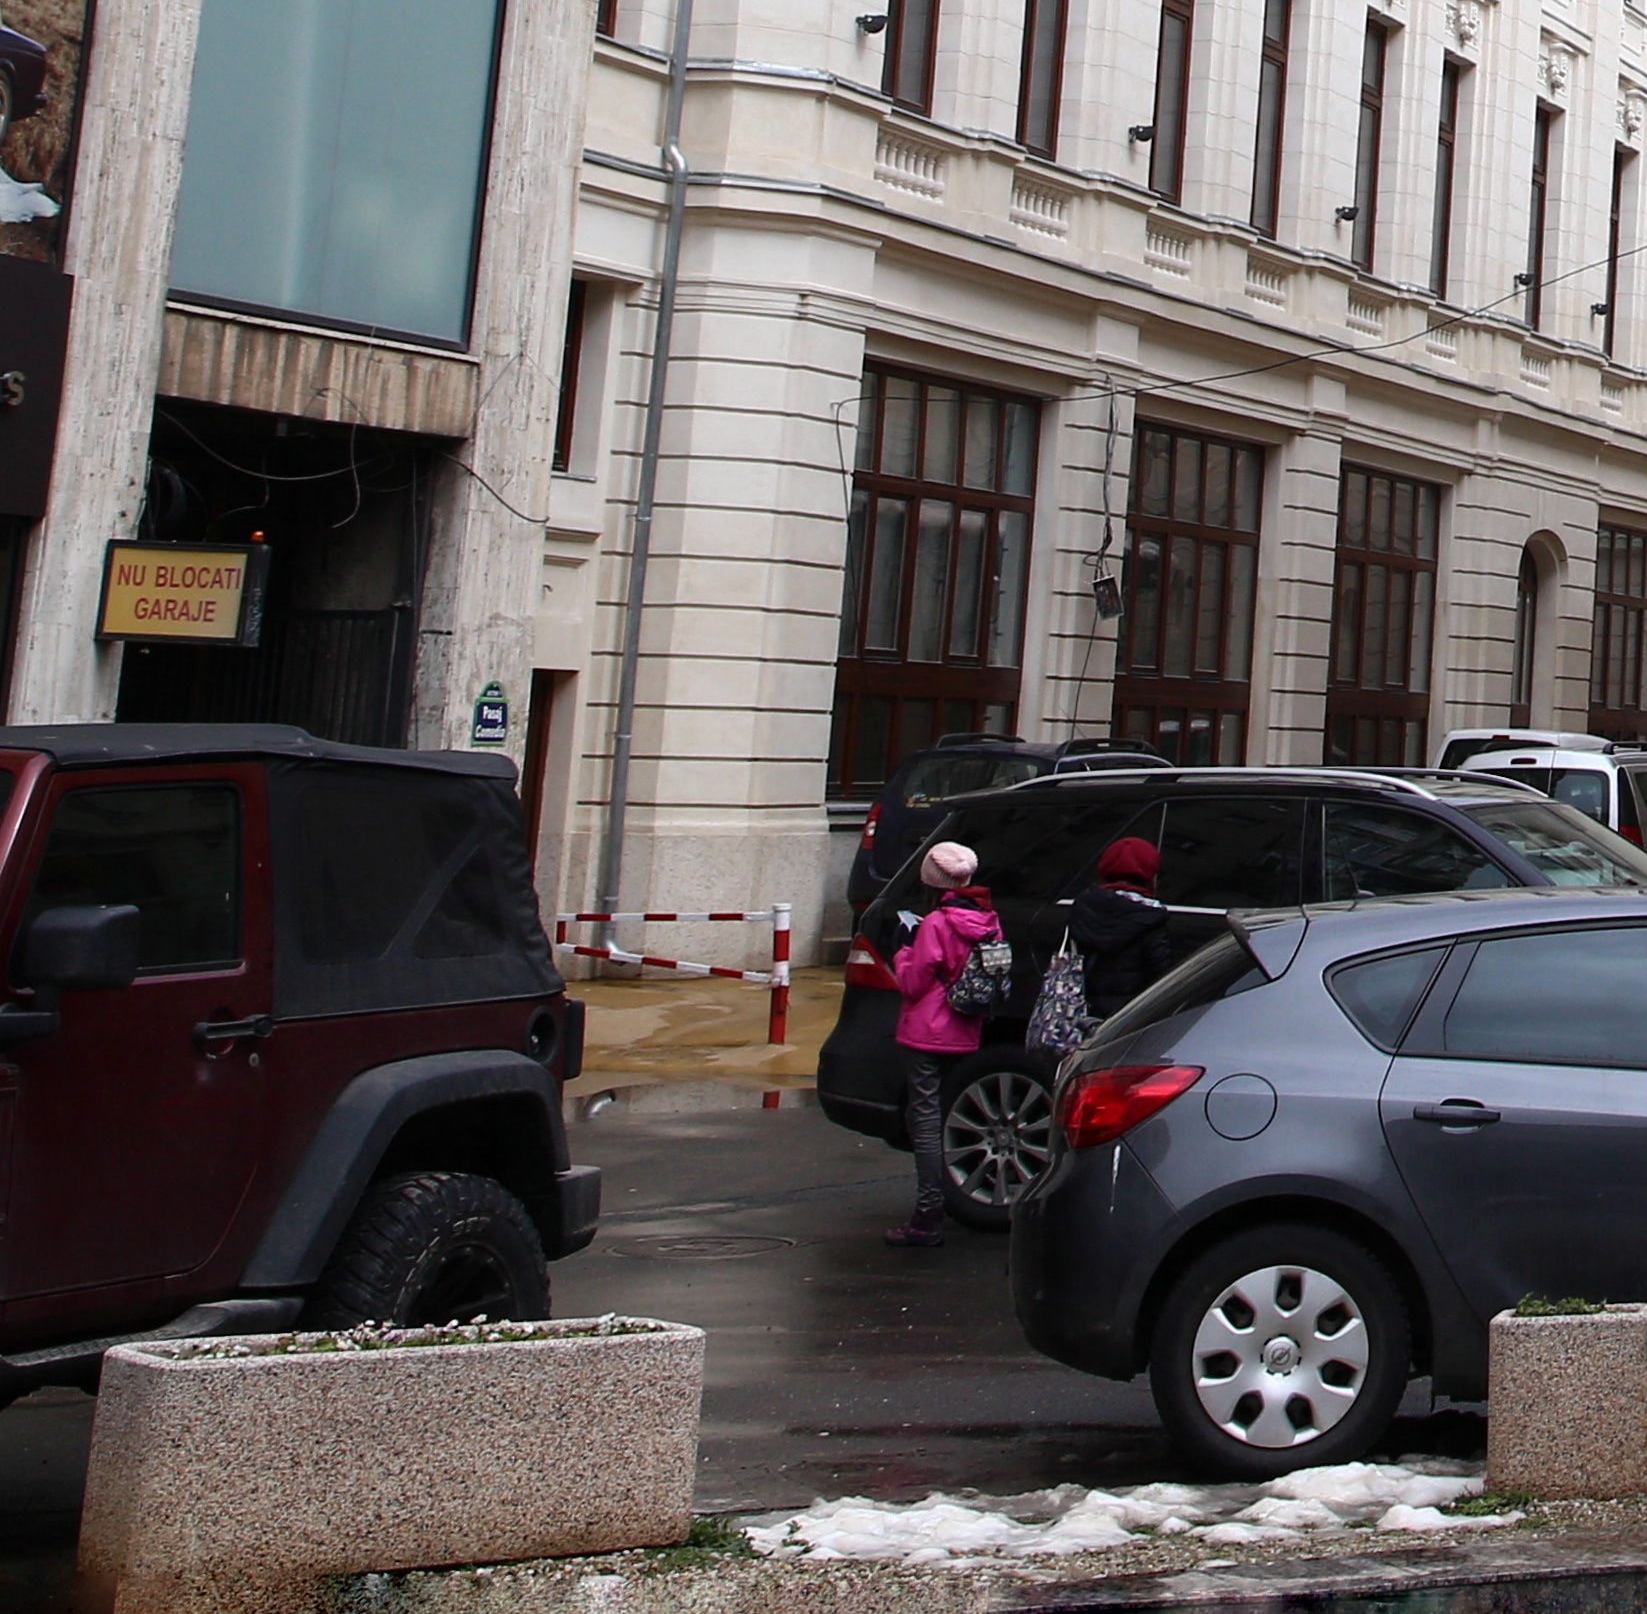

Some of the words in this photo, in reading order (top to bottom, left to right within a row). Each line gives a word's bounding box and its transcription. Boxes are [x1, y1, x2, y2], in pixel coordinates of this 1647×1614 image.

[117, 564, 146, 587] NU
[155, 565, 241, 590] BLOCATI
[134, 597, 217, 623] GARAJE
[482, 705, 503, 724] Pasaj
